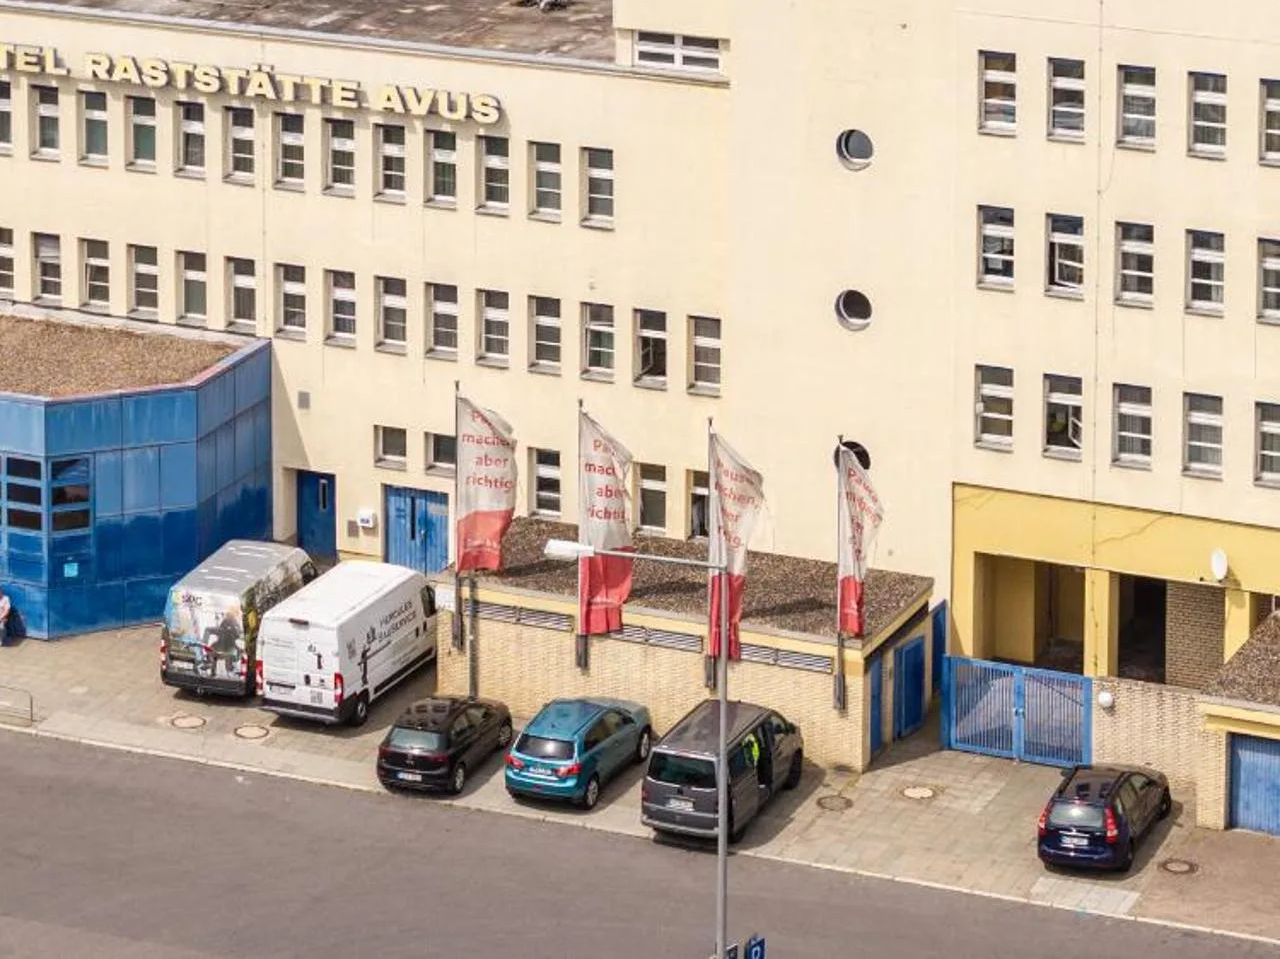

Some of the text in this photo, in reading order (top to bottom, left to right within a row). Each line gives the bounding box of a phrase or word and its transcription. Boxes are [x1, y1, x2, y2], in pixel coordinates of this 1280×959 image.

[84, 52, 362, 108] RASTSTÄTTE
[375, 83, 502, 124] AVUS
[475, 453, 509, 468] aber
[465, 472, 515, 493] richtig
